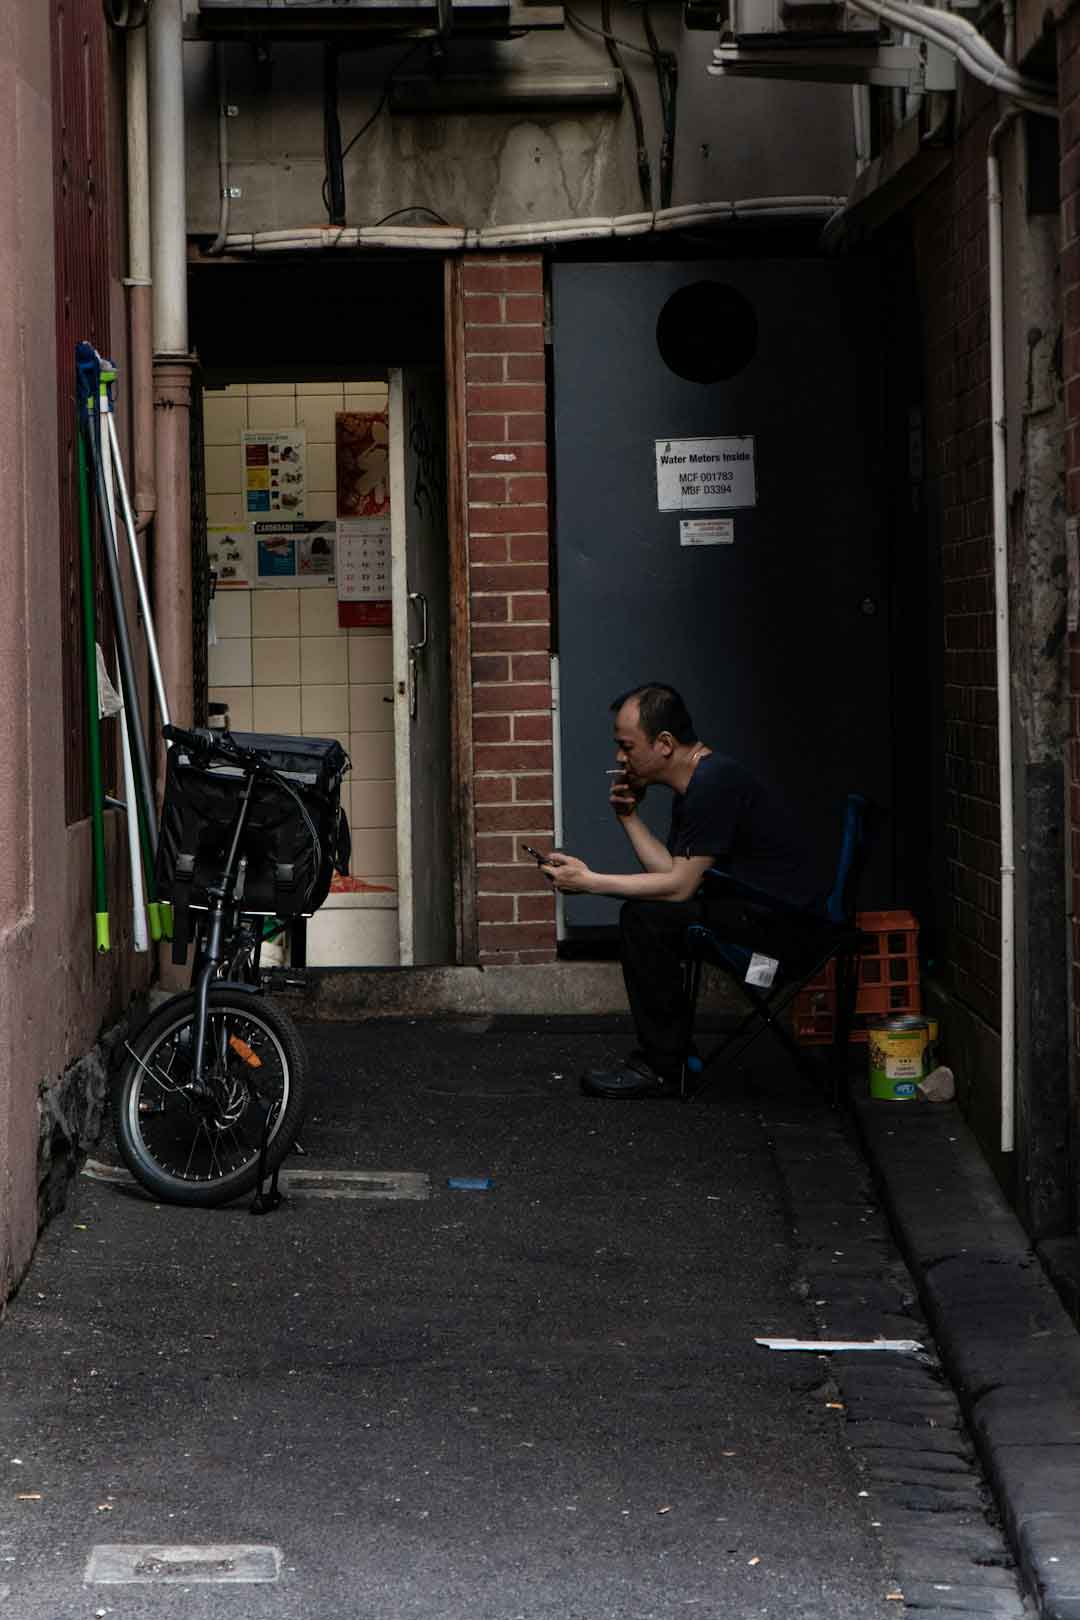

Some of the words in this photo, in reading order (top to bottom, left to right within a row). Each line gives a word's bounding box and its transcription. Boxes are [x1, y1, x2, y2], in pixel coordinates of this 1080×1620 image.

[660, 455, 687, 464] Water
[689, 454, 720, 463] Meters
[723, 452, 750, 462] Inside
[679, 472, 699, 482] MCF
[700, 471, 734, 482] 001783
